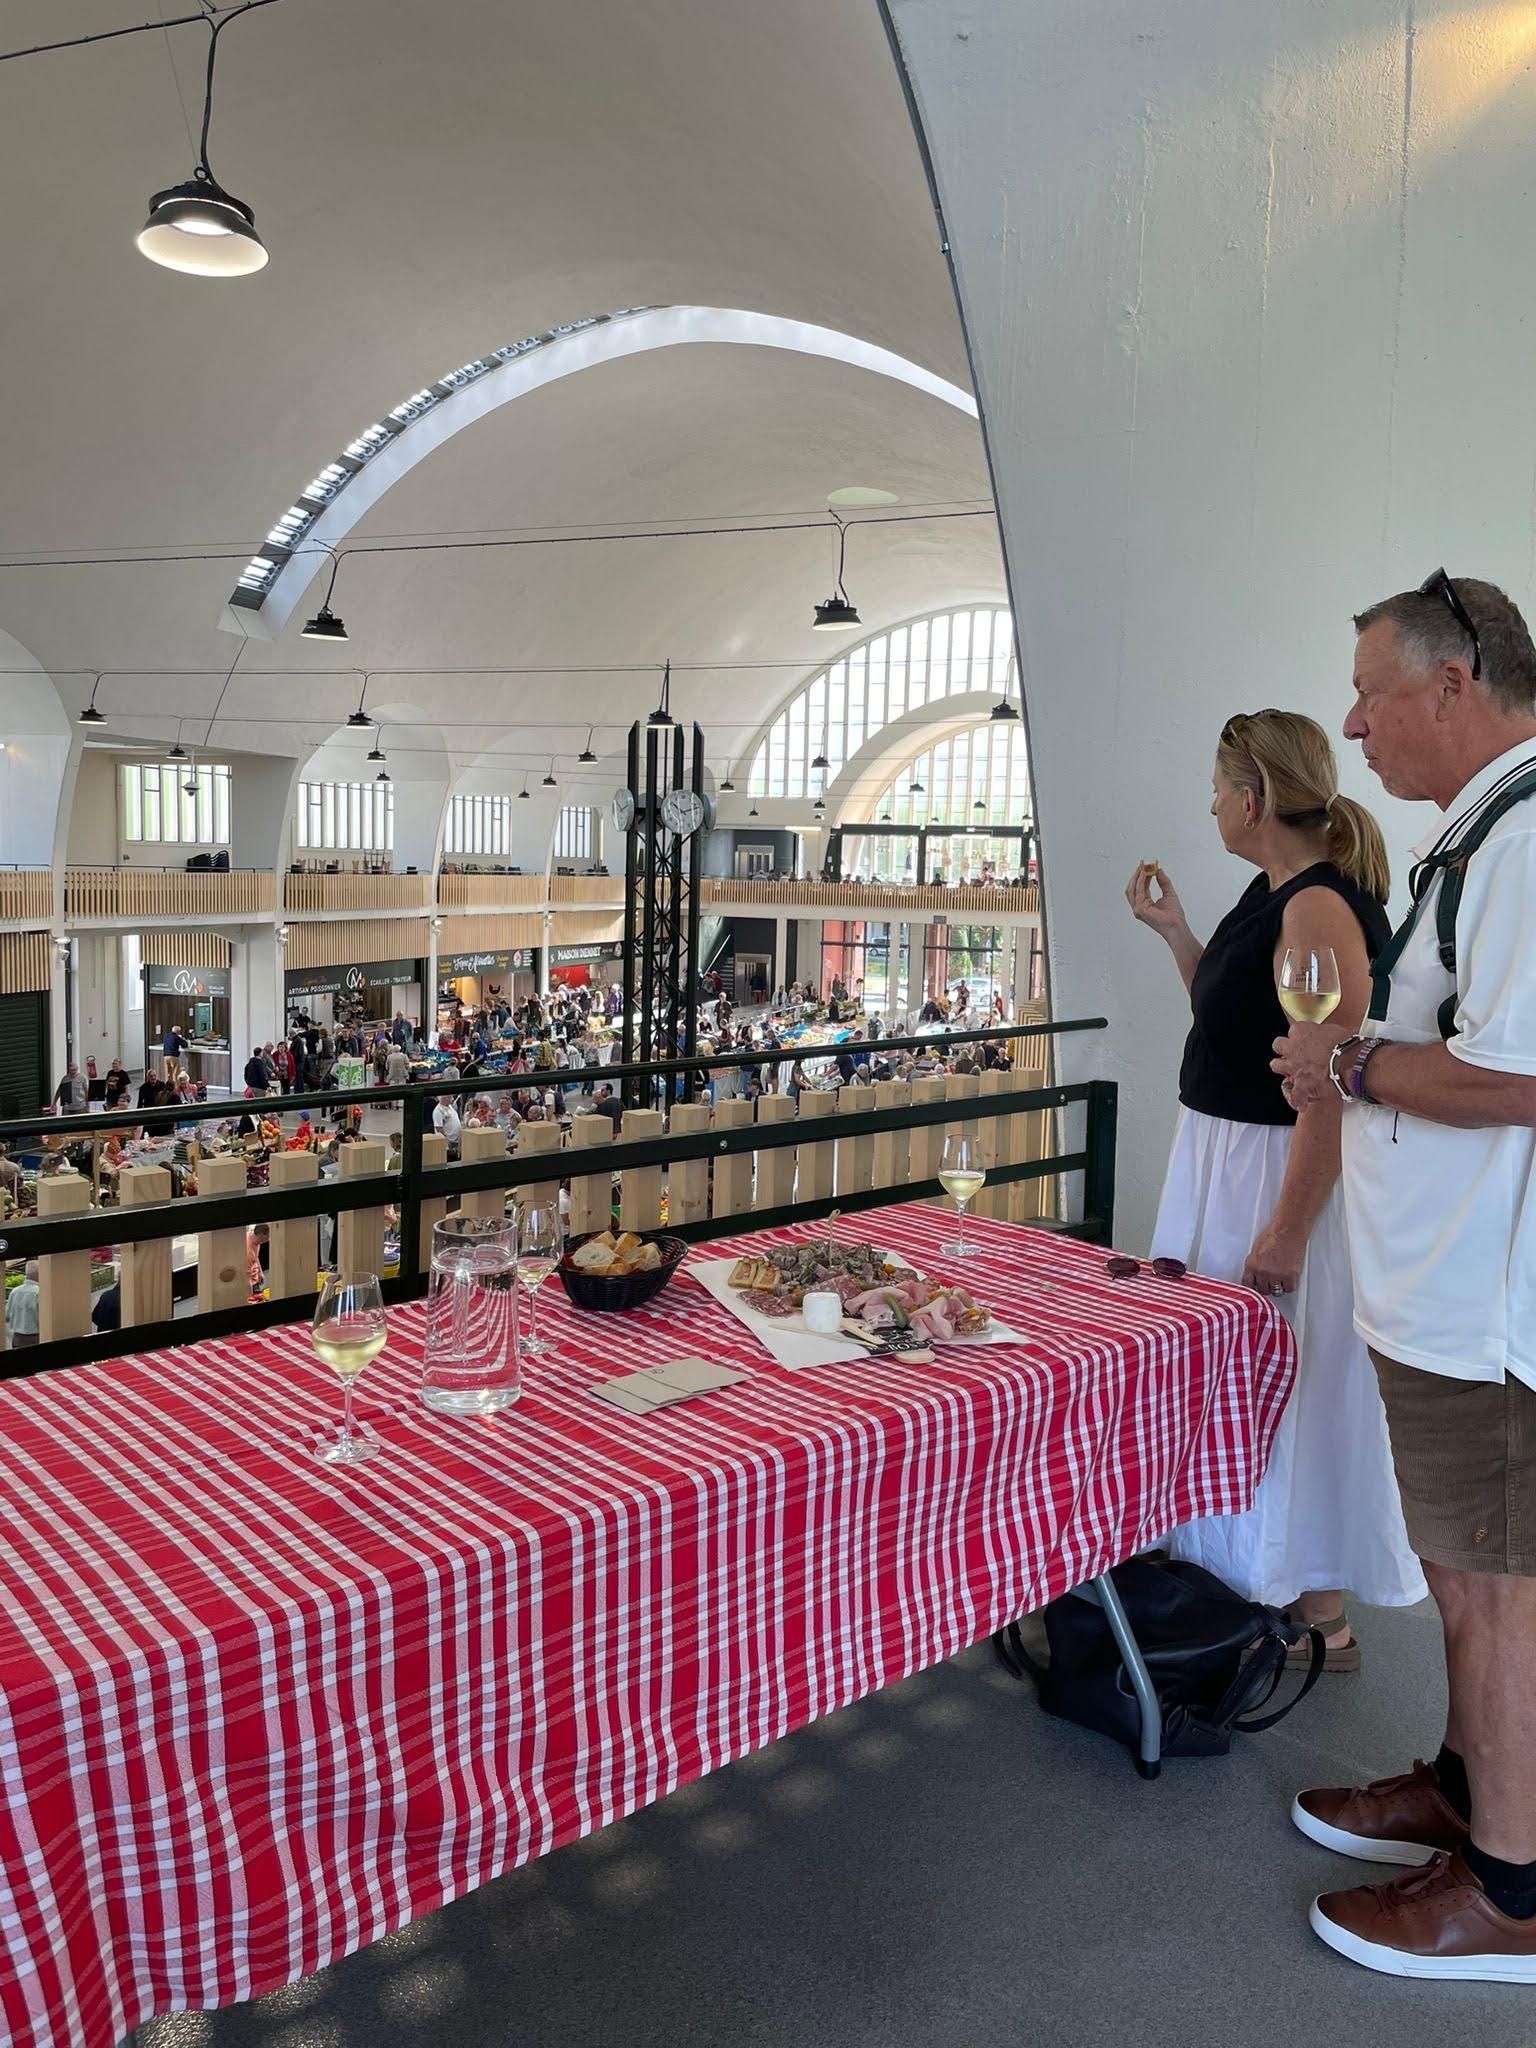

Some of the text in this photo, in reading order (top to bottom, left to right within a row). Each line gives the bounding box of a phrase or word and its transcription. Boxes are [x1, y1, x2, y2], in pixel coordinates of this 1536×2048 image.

[557, 949, 579, 961] MAISON
[289, 983, 341, 995] ARTISAN POISSONNIER
